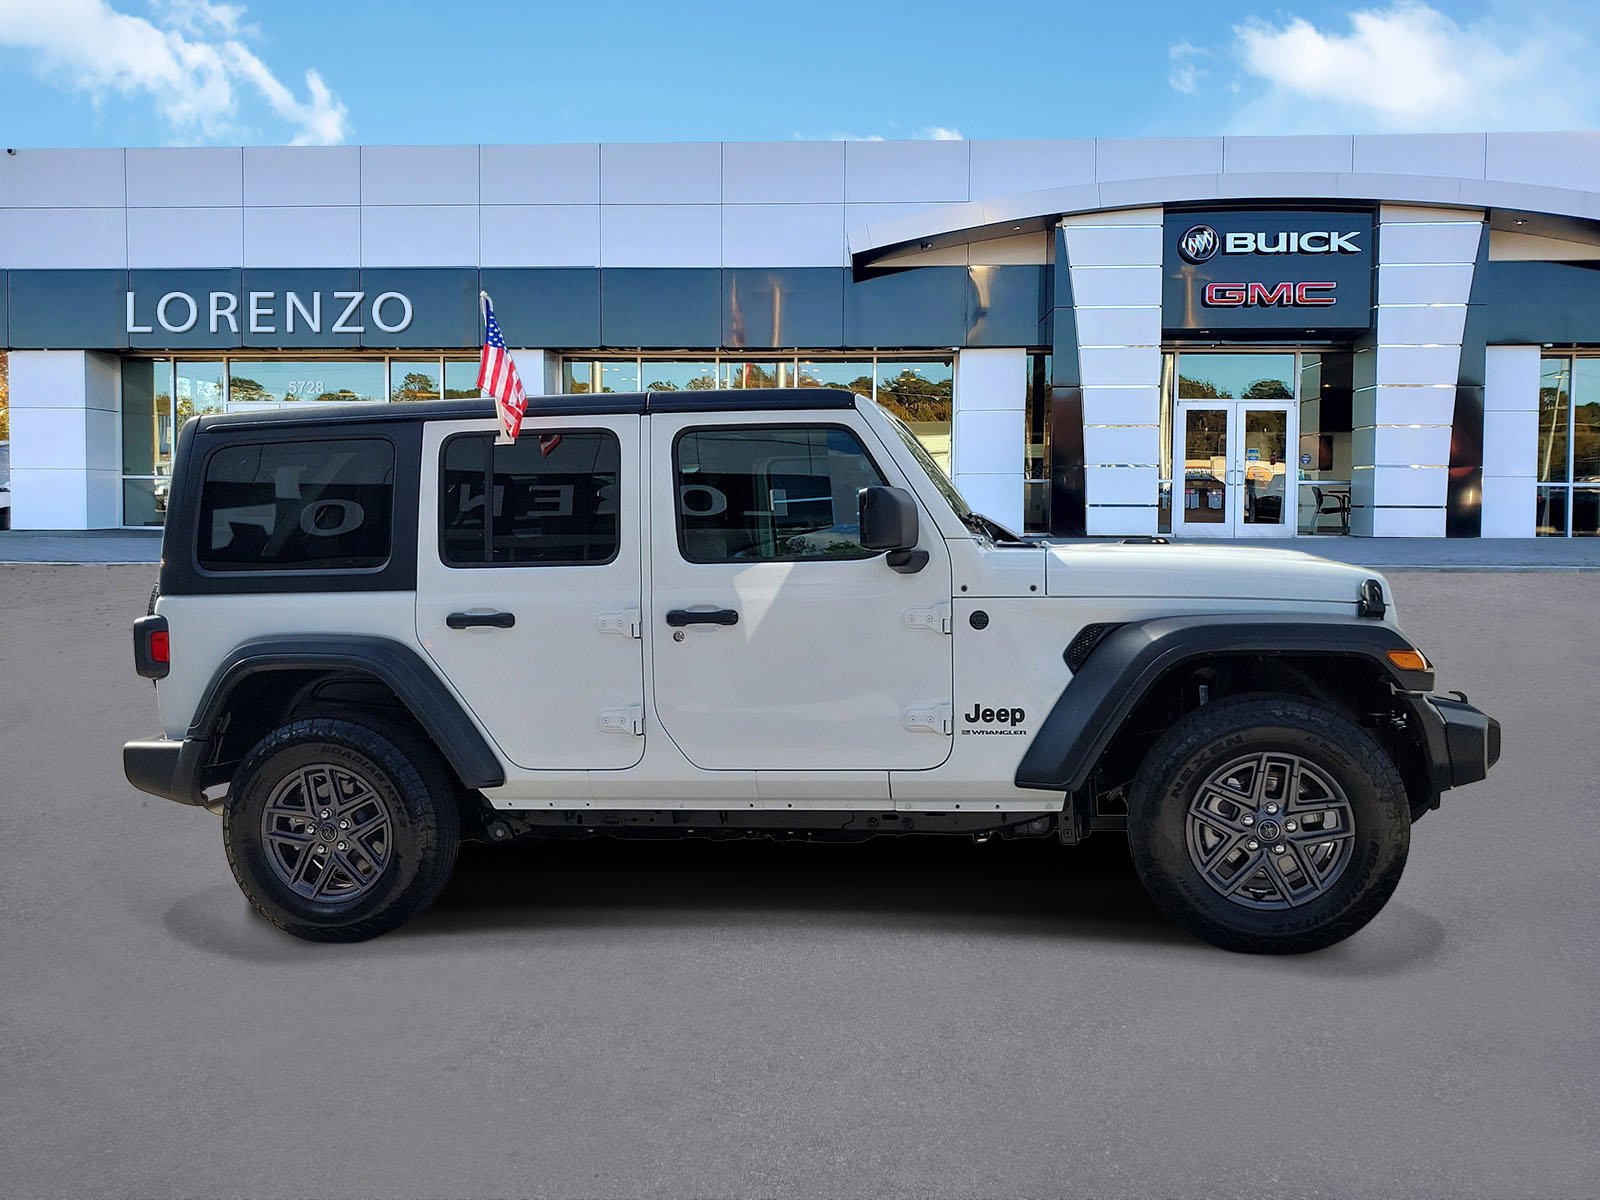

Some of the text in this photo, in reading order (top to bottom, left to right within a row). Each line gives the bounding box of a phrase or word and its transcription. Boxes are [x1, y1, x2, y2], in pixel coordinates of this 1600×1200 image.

[1225, 231, 1361, 253] BUICK
[1204, 281, 1337, 305] GMC
[126, 290, 413, 334] LORENZO
[288, 381, 324, 394] 5728
[964, 703, 1025, 726] Jeep
